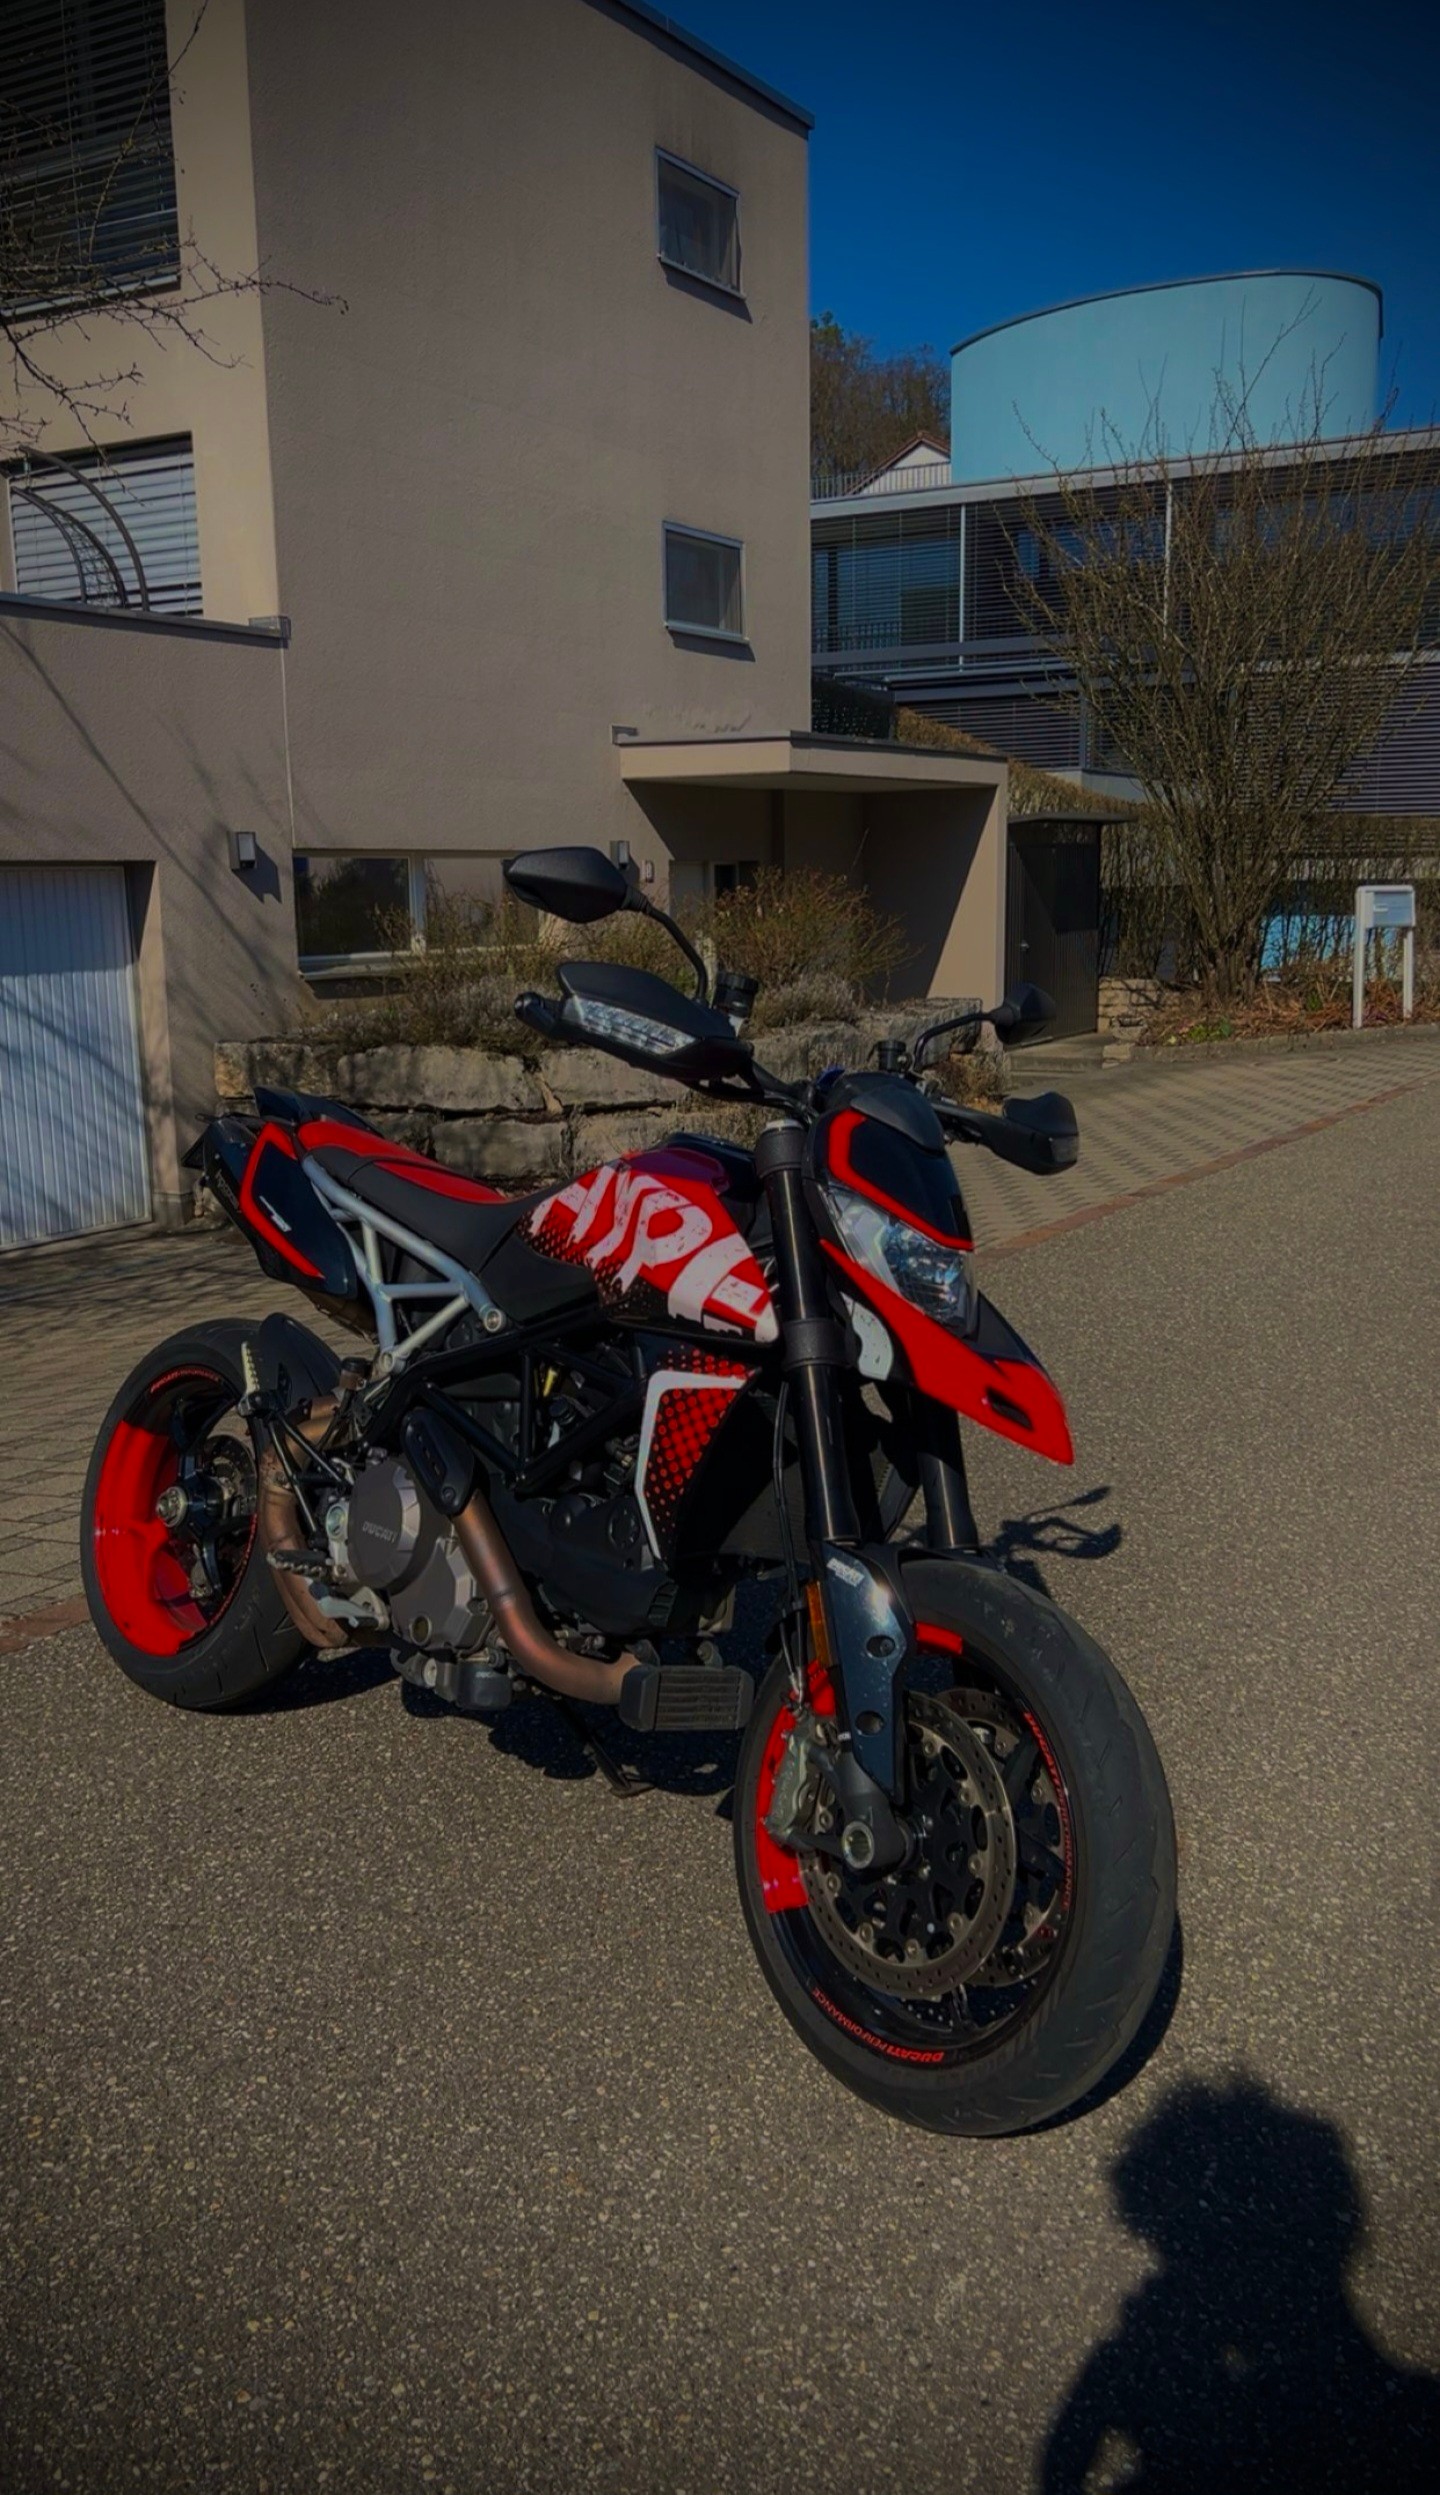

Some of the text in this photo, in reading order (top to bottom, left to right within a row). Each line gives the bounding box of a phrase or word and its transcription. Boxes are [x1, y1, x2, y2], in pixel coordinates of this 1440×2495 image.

[362, 1520, 397, 1543] DUCATI
[811, 1986, 944, 2063] DUCATI PERFORMANCE
